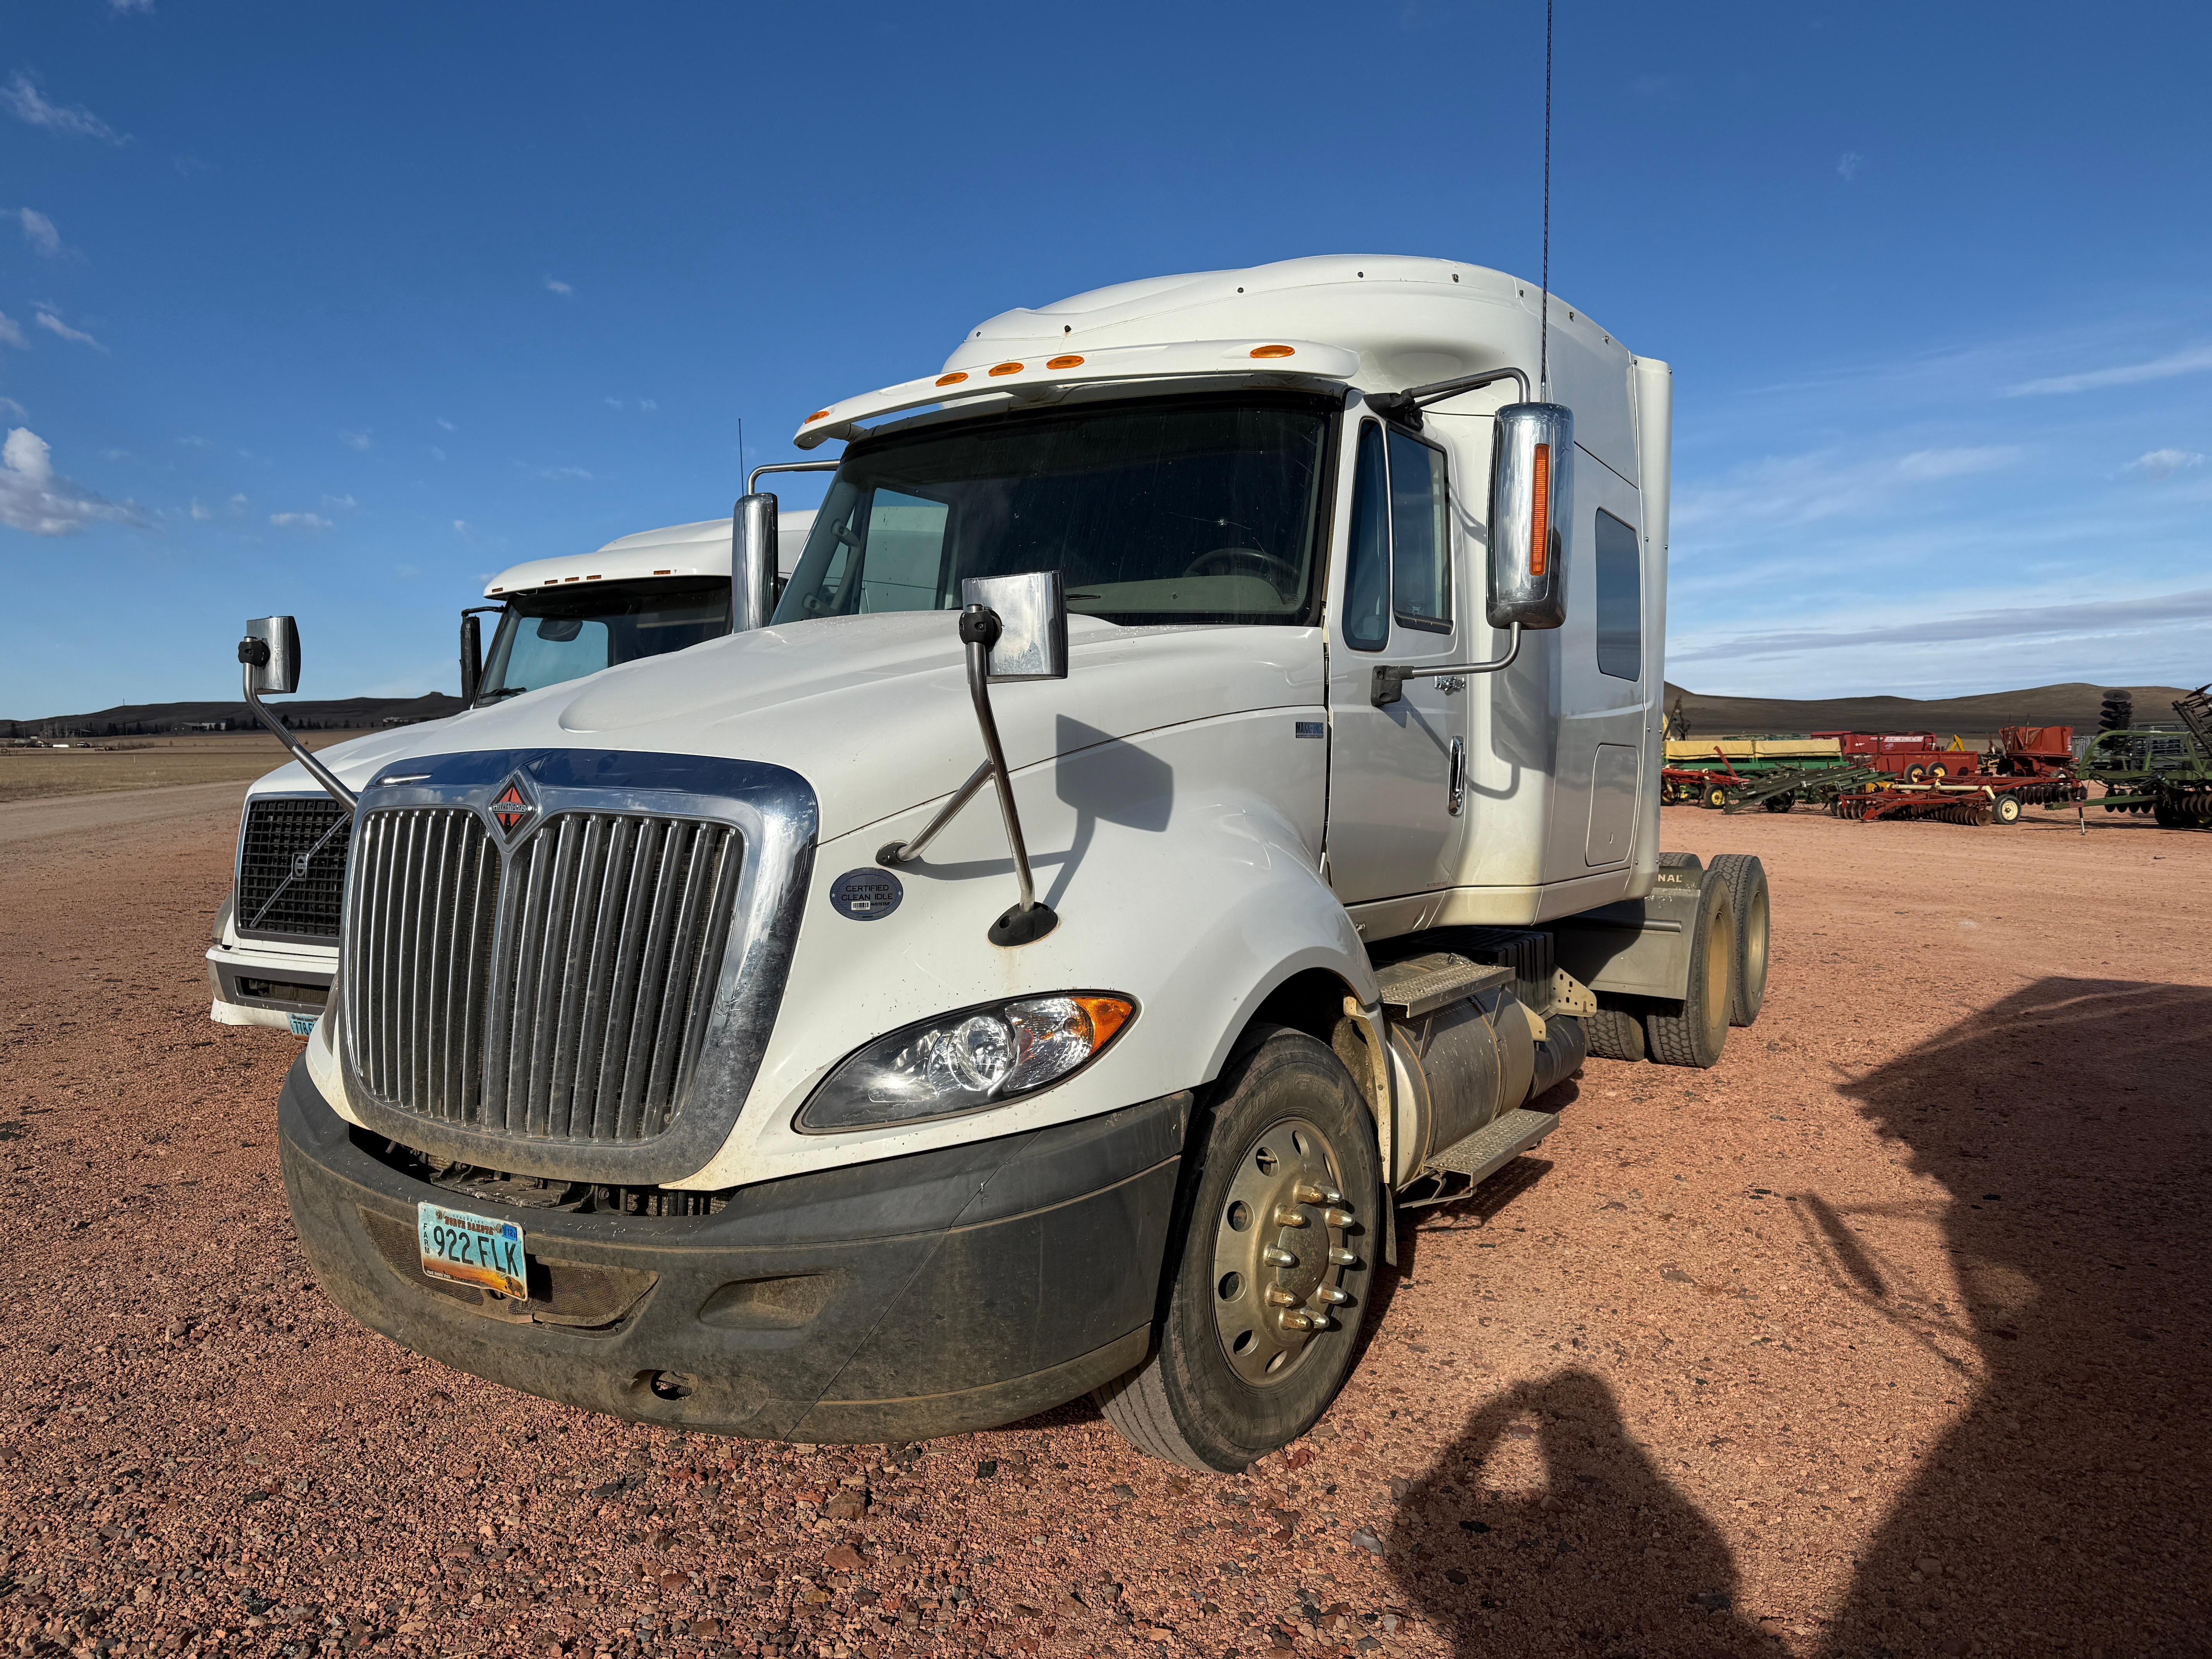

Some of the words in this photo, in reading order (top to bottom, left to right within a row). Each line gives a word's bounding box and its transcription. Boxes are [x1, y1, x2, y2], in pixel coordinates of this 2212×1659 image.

[1297, 722, 1324, 734] MAXXFORCE
[1656, 874, 1682, 883] NAL
[293, 1021, 309, 1036] 778
[308, 1023, 314, 1034] F
[444, 1216, 466, 1230] NORTH
[467, 1222, 495, 1235] DAKOTA
[507, 1228, 514, 1237] 12
[433, 1225, 474, 1265] 922
[477, 1235, 519, 1278] FLK
